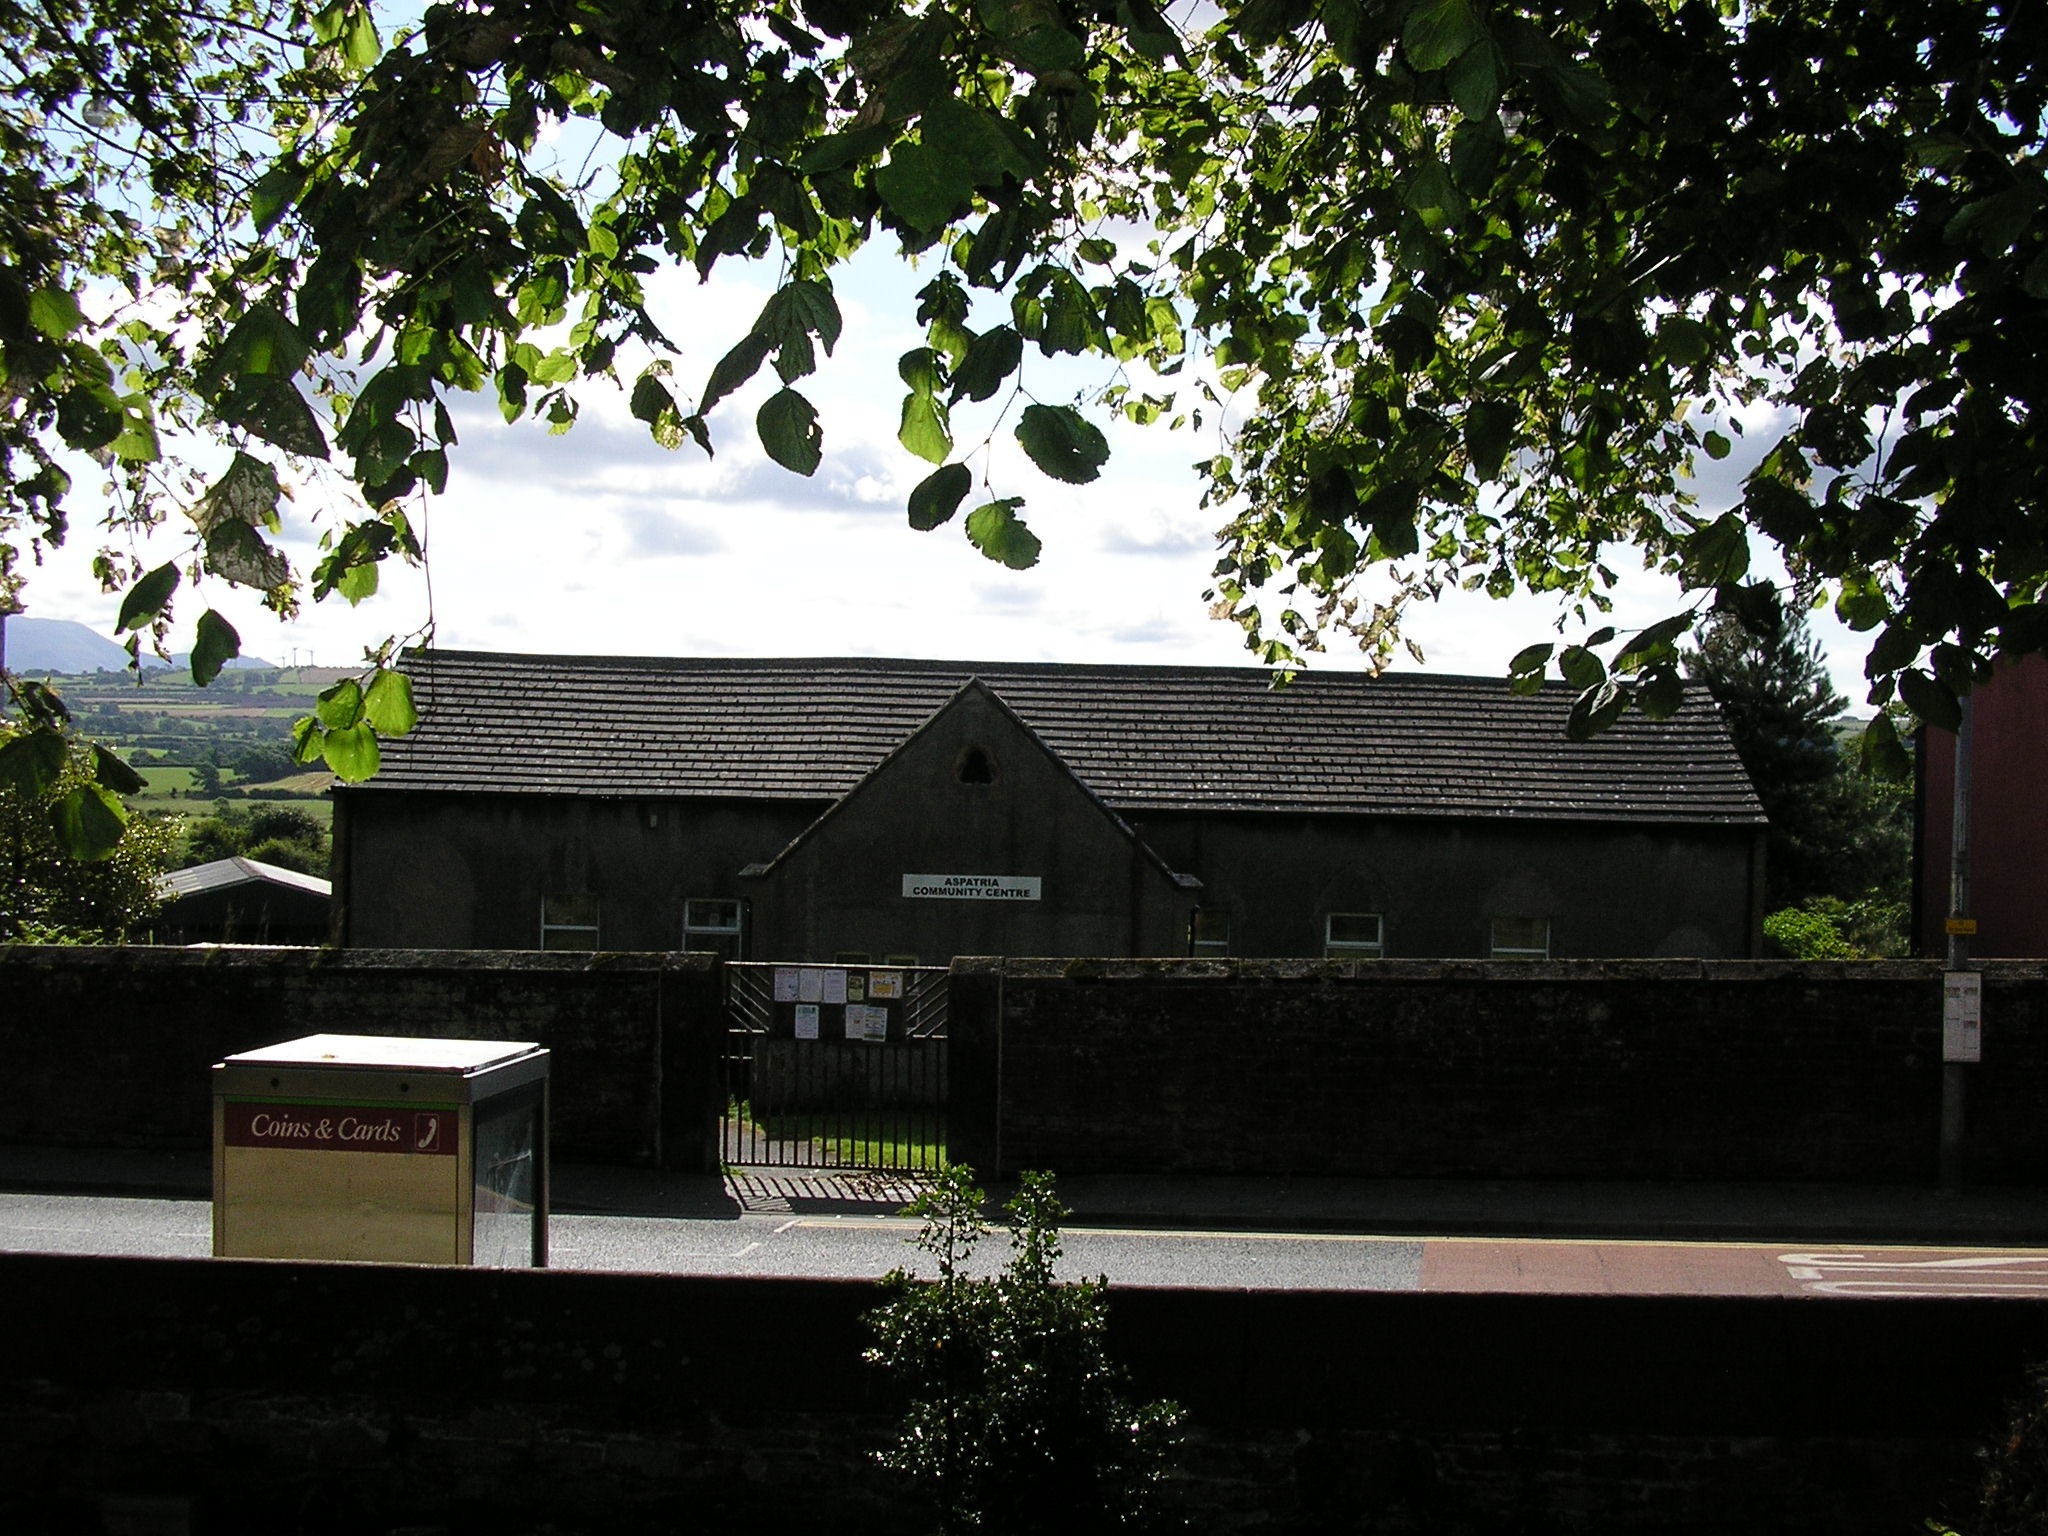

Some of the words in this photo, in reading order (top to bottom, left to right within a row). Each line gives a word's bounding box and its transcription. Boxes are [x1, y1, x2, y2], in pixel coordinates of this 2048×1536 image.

[944, 878, 999, 887] ASPATRIA
[912, 886, 981, 897] COMMUNITY
[985, 888, 1030, 898] CENTRE
[251, 1113, 311, 1137] Coins
[313, 1118, 333, 1139] &
[337, 1117, 401, 1142] Cards
